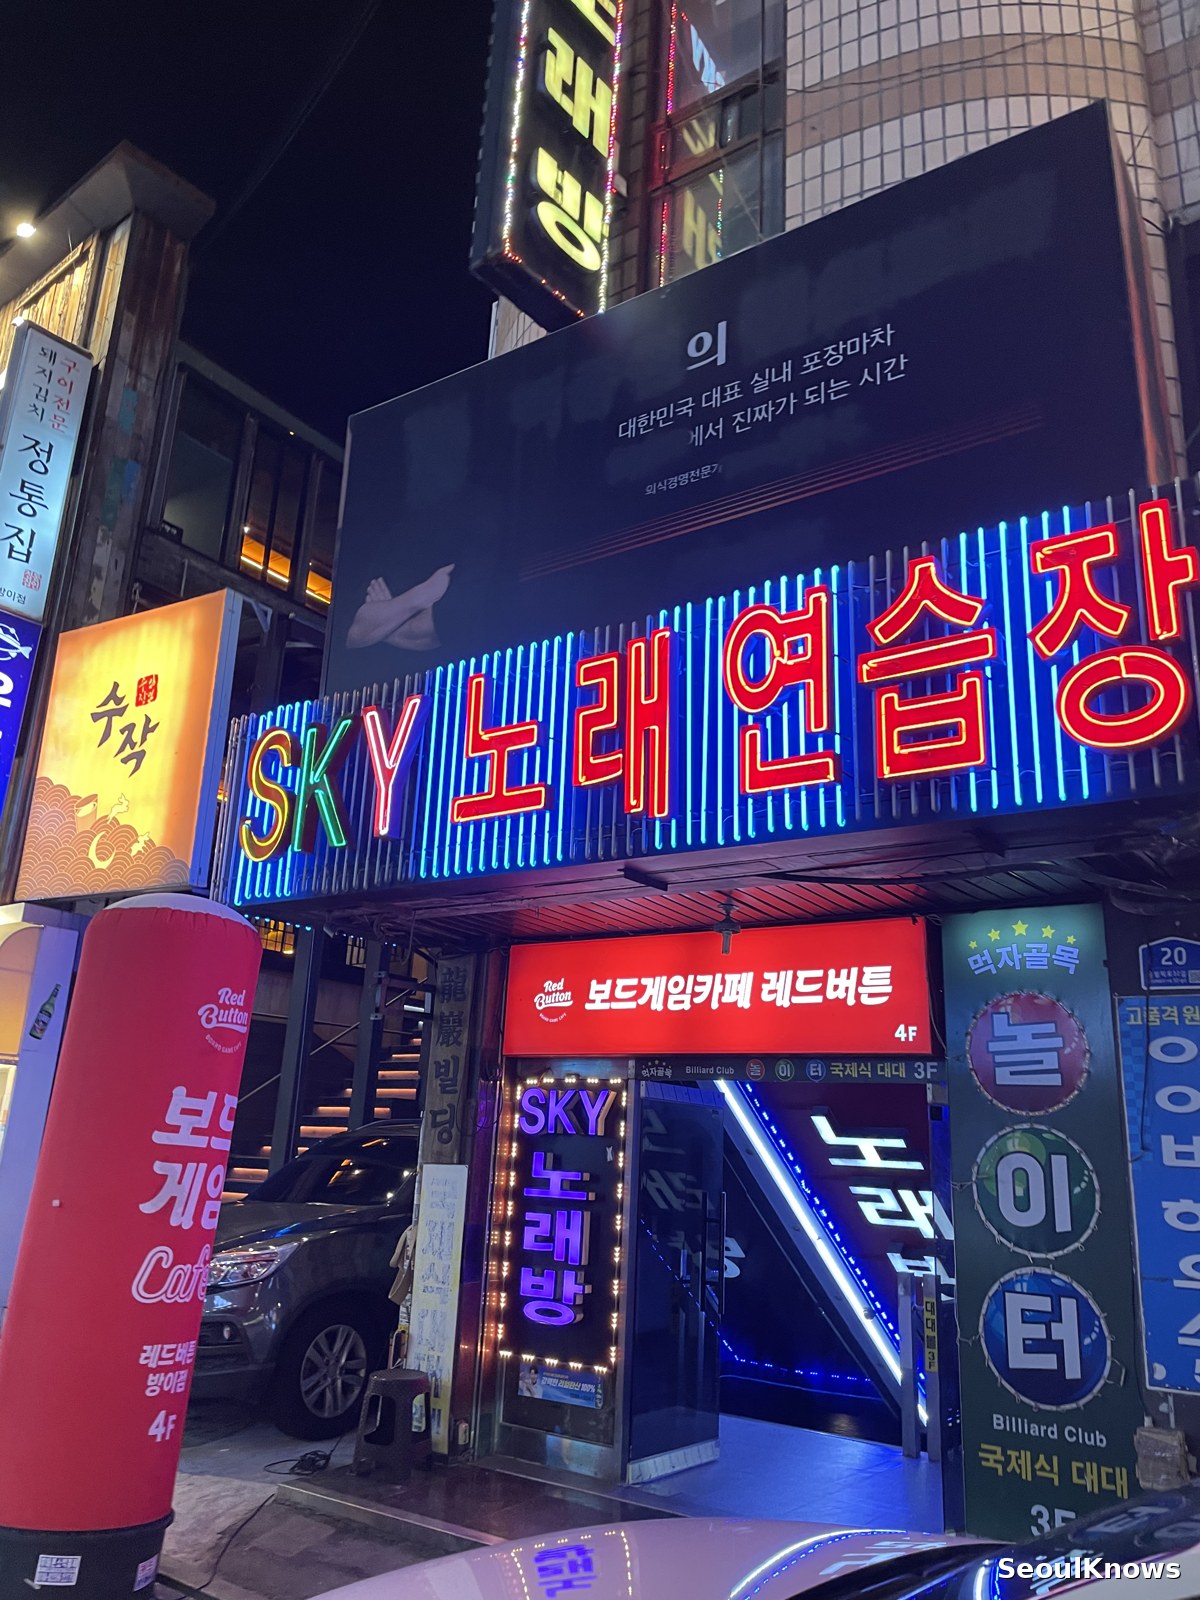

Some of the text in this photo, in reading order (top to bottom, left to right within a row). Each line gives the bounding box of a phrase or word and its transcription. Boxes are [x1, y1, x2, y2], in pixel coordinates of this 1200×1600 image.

[686, 320, 727, 371] 의
[49, 357, 80, 434] 구이전문
[618, 323, 895, 439] 대한민국 대표 실내 포장마차
[731, 392, 798, 434] 진짜가
[803, 377, 851, 406] 되는
[858, 353, 909, 387] 시간
[0, 434, 54, 564] 정통집
[239, 498, 1199, 862] SKY 노래연습장
[90, 681, 160, 778] 수작
[967, 943, 1080, 975] 먹자골목
[1161, 946, 1187, 965] 20
[217, 987, 246, 1006] Red
[533, 991, 574, 1010] Button
[543, 977, 565, 992] Red
[584, 965, 893, 1011] 보드게임카페 레드버튼
[198, 1004, 248, 1033] Button
[894, 1024, 918, 1042] 4F
[685, 1065, 714, 1075] Billiard
[716, 1065, 735, 1075] Club
[830, 1063, 872, 1078] 국제식
[877, 1062, 906, 1078] 대대
[914, 1062, 938, 1079] 3F
[519, 1088, 609, 1135] SKY
[519, 1151, 588, 1327] 노래방
[139, 1340, 197, 1368] 레드버튼
[145, 1369, 188, 1396] 방이점
[148, 1410, 177, 1442] 4F
[992, 1413, 1107, 1448] Billiard Club
[978, 1443, 1129, 1499] 국제식 대대
